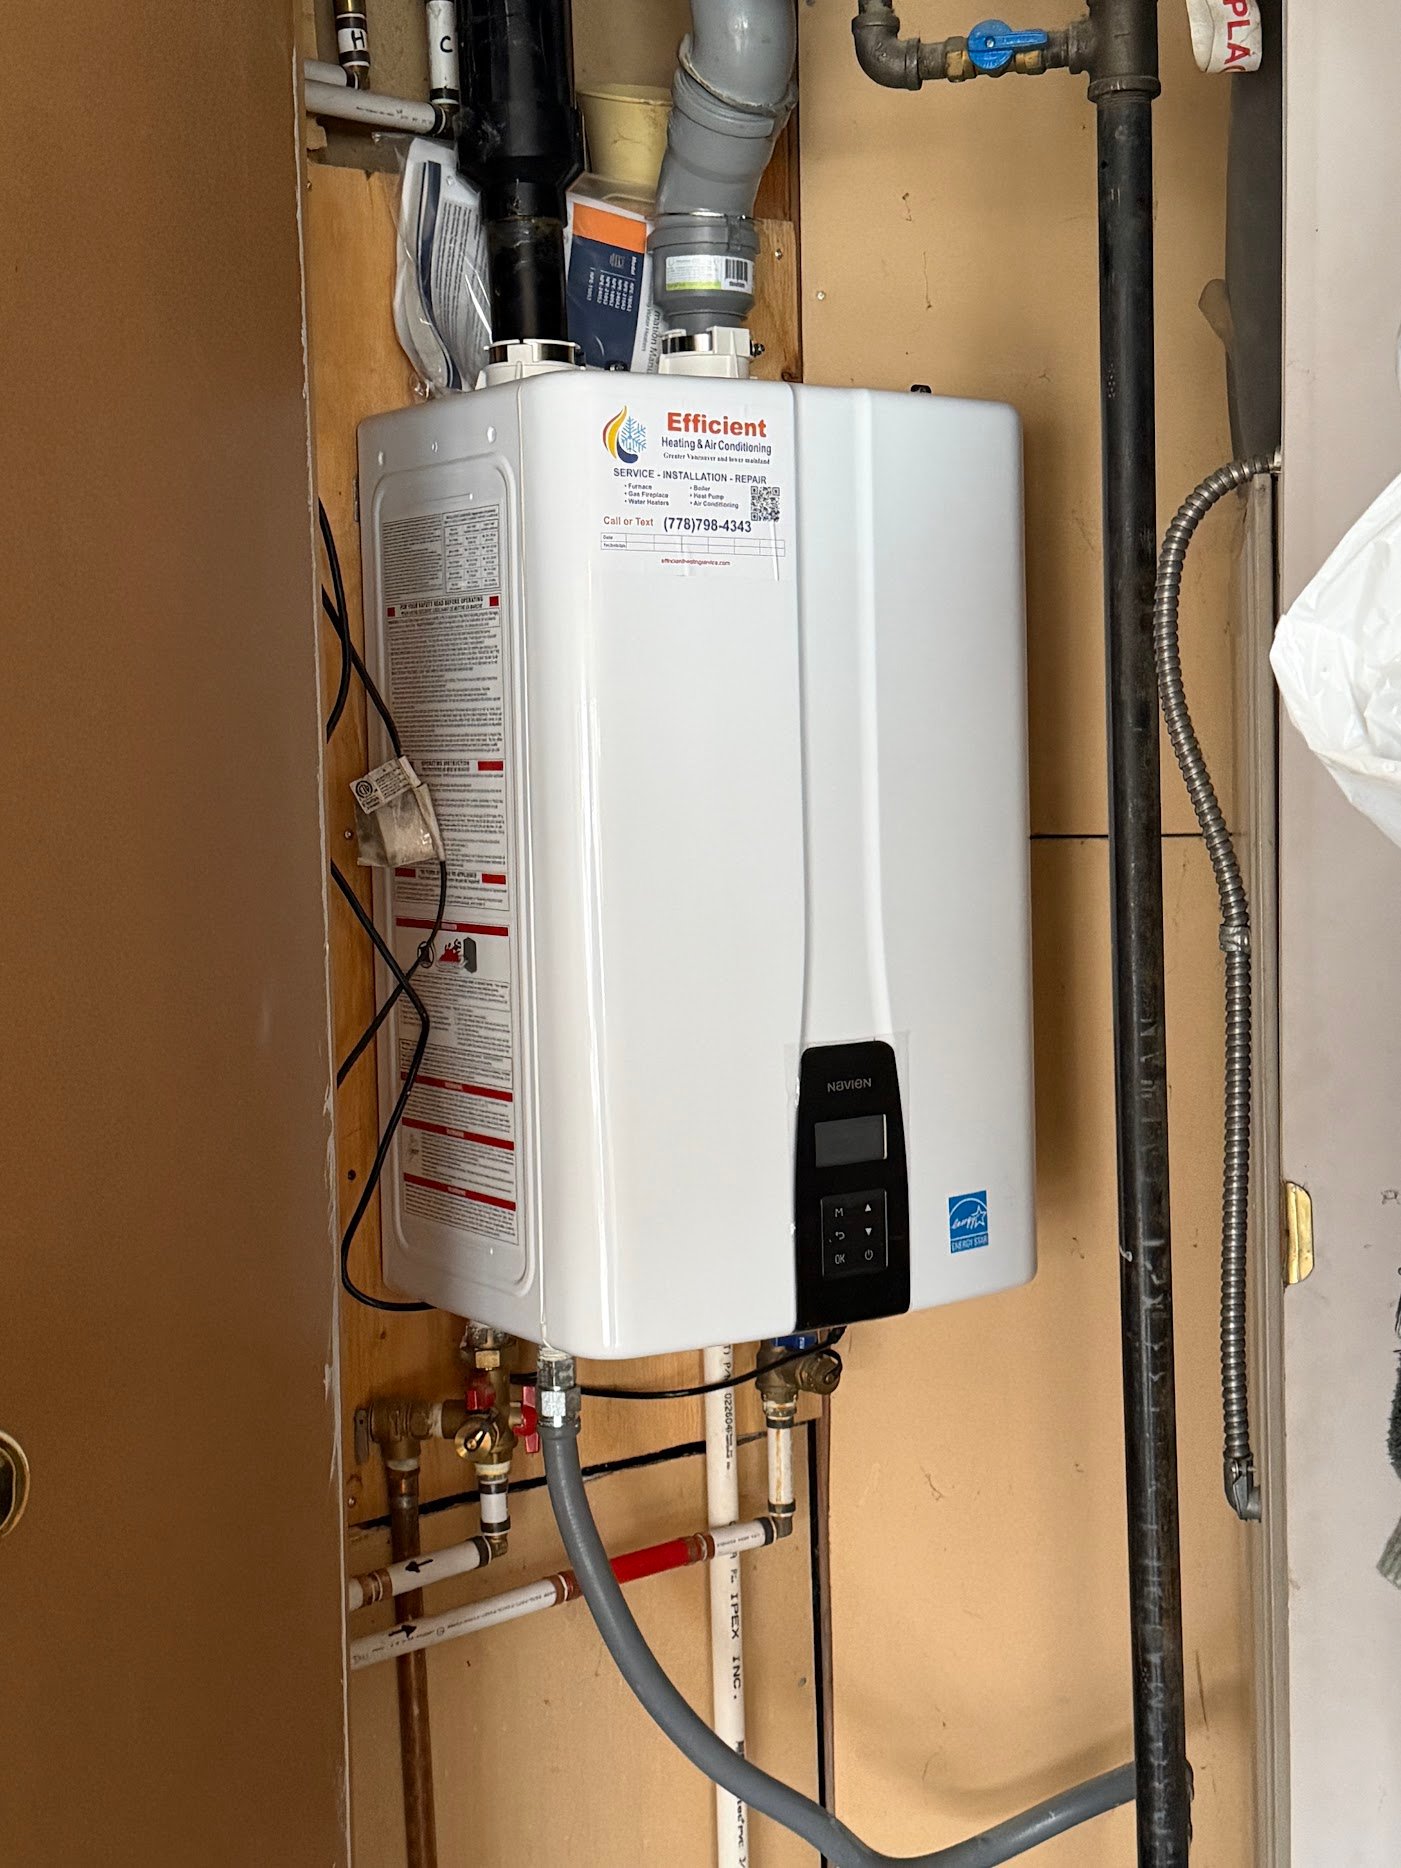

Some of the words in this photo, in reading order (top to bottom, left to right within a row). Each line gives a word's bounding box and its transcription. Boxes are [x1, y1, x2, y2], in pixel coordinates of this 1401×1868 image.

[351, 29, 365, 50] H
[440, 35, 453, 53] C
[667, 412, 767, 438] Efficient
[661, 436, 696, 451] Heating
[697, 438, 703, 449] &
[704, 439, 717, 450] Air
[718, 440, 772, 456] Conditioning
[663, 452, 686, 460] Greater
[687, 453, 716, 462] Vancouver
[745, 457, 770, 465] mainland
[613, 468, 655, 479] SERVICE
[662, 470, 728, 482] INSTALLATION
[735, 474, 767, 485] REPAIR
[642, 491, 669, 499] Fireplace
[703, 501, 739, 509] Conditioning
[603, 516, 621, 525] Call
[623, 518, 633, 526] or
[636, 517, 654, 527] Text
[663, 517, 752, 533] (778)798-4343
[834, 1208, 844, 1218] M
[834, 1254, 846, 1265] OK
[730, 1593, 740, 1640] IPEX
[732, 1656, 742, 1700] INC.
